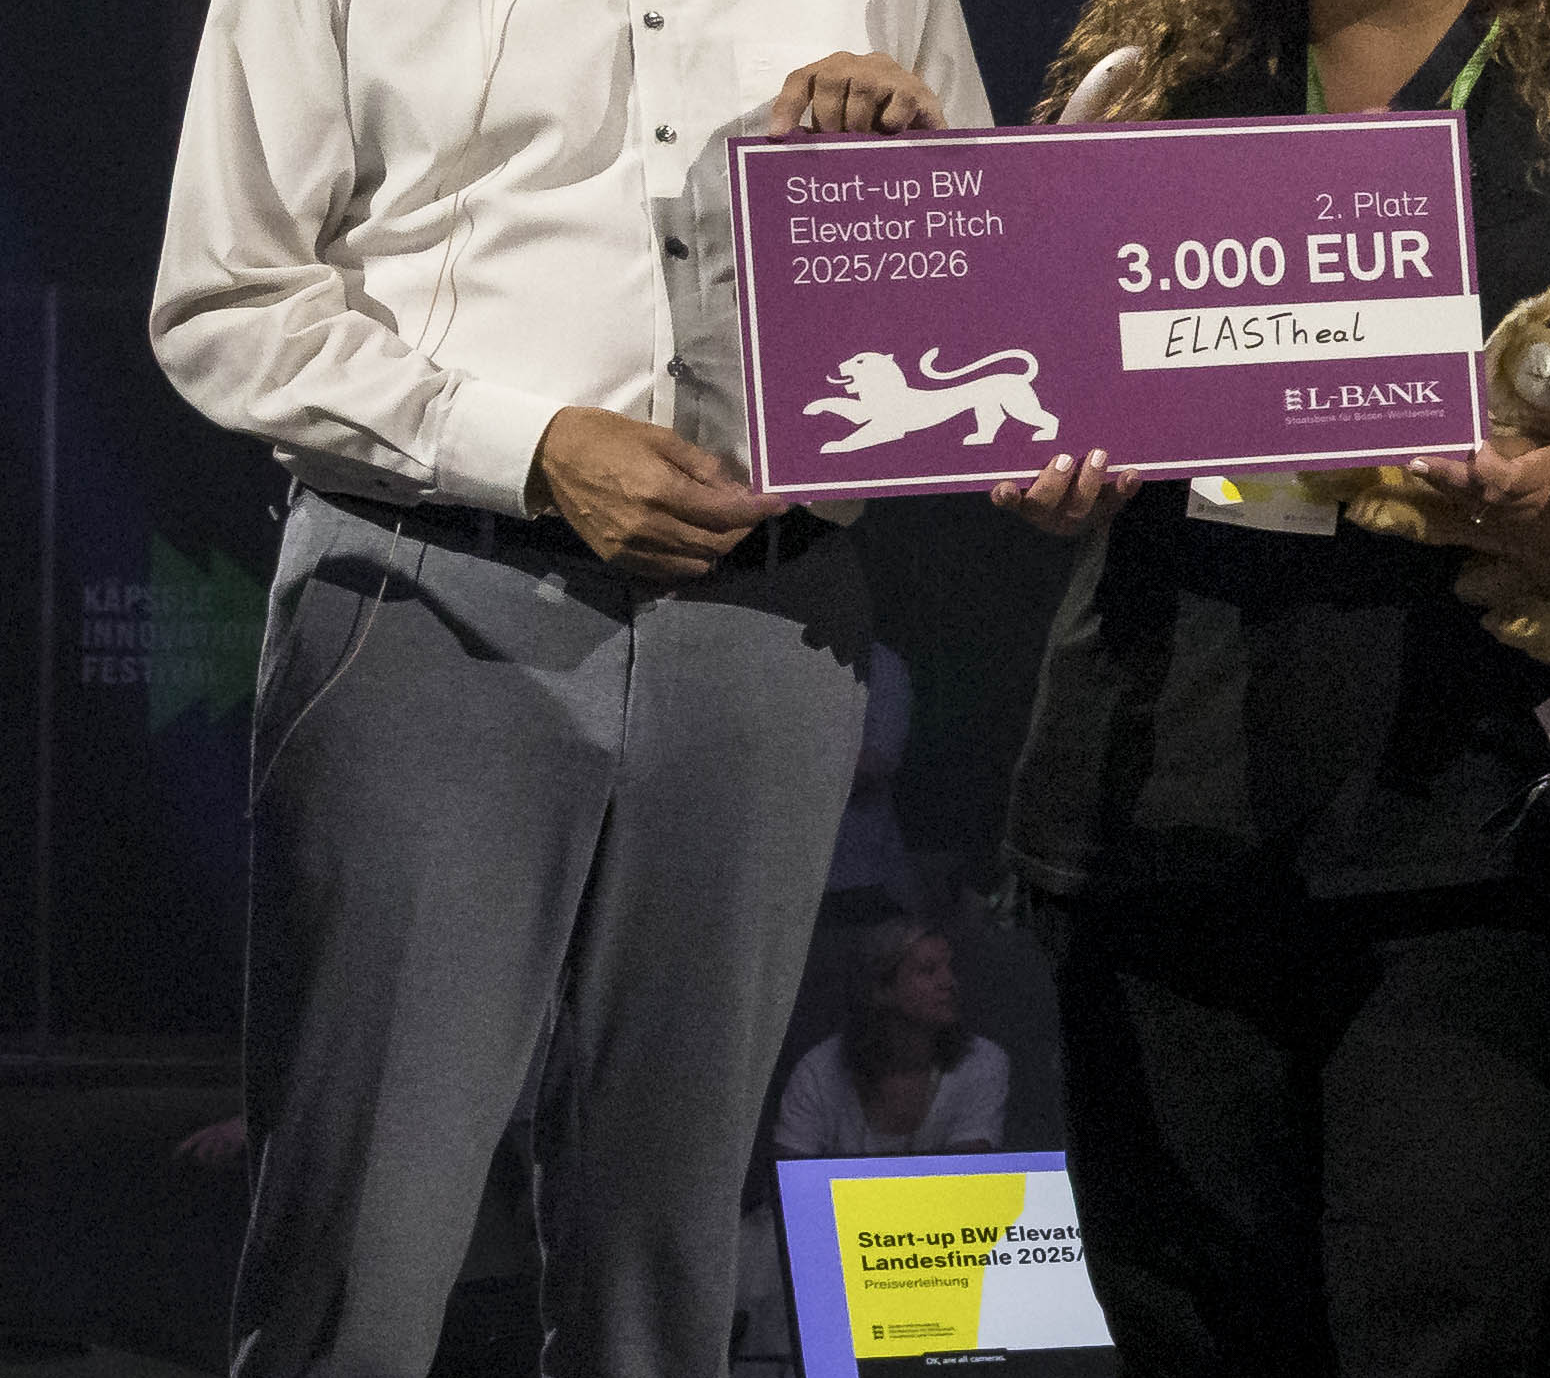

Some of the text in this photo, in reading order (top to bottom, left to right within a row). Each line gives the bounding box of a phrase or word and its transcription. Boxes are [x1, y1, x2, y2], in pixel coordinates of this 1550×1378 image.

[786, 169, 983, 206] Start-up BW
[1315, 191, 1429, 220] 2. Platz
[790, 209, 1003, 244] Elevator Pitch
[791, 249, 968, 284] 2025/2026
[1117, 230, 1434, 293] 3.000 EUR
[1306, 380, 1443, 410] L-BANK
[858, 1230, 956, 1248] Start-up
[961, 1226, 998, 1245] BW
[861, 1250, 1013, 1271] Landesfinale
[864, 1276, 970, 1290] Preisverleihung
